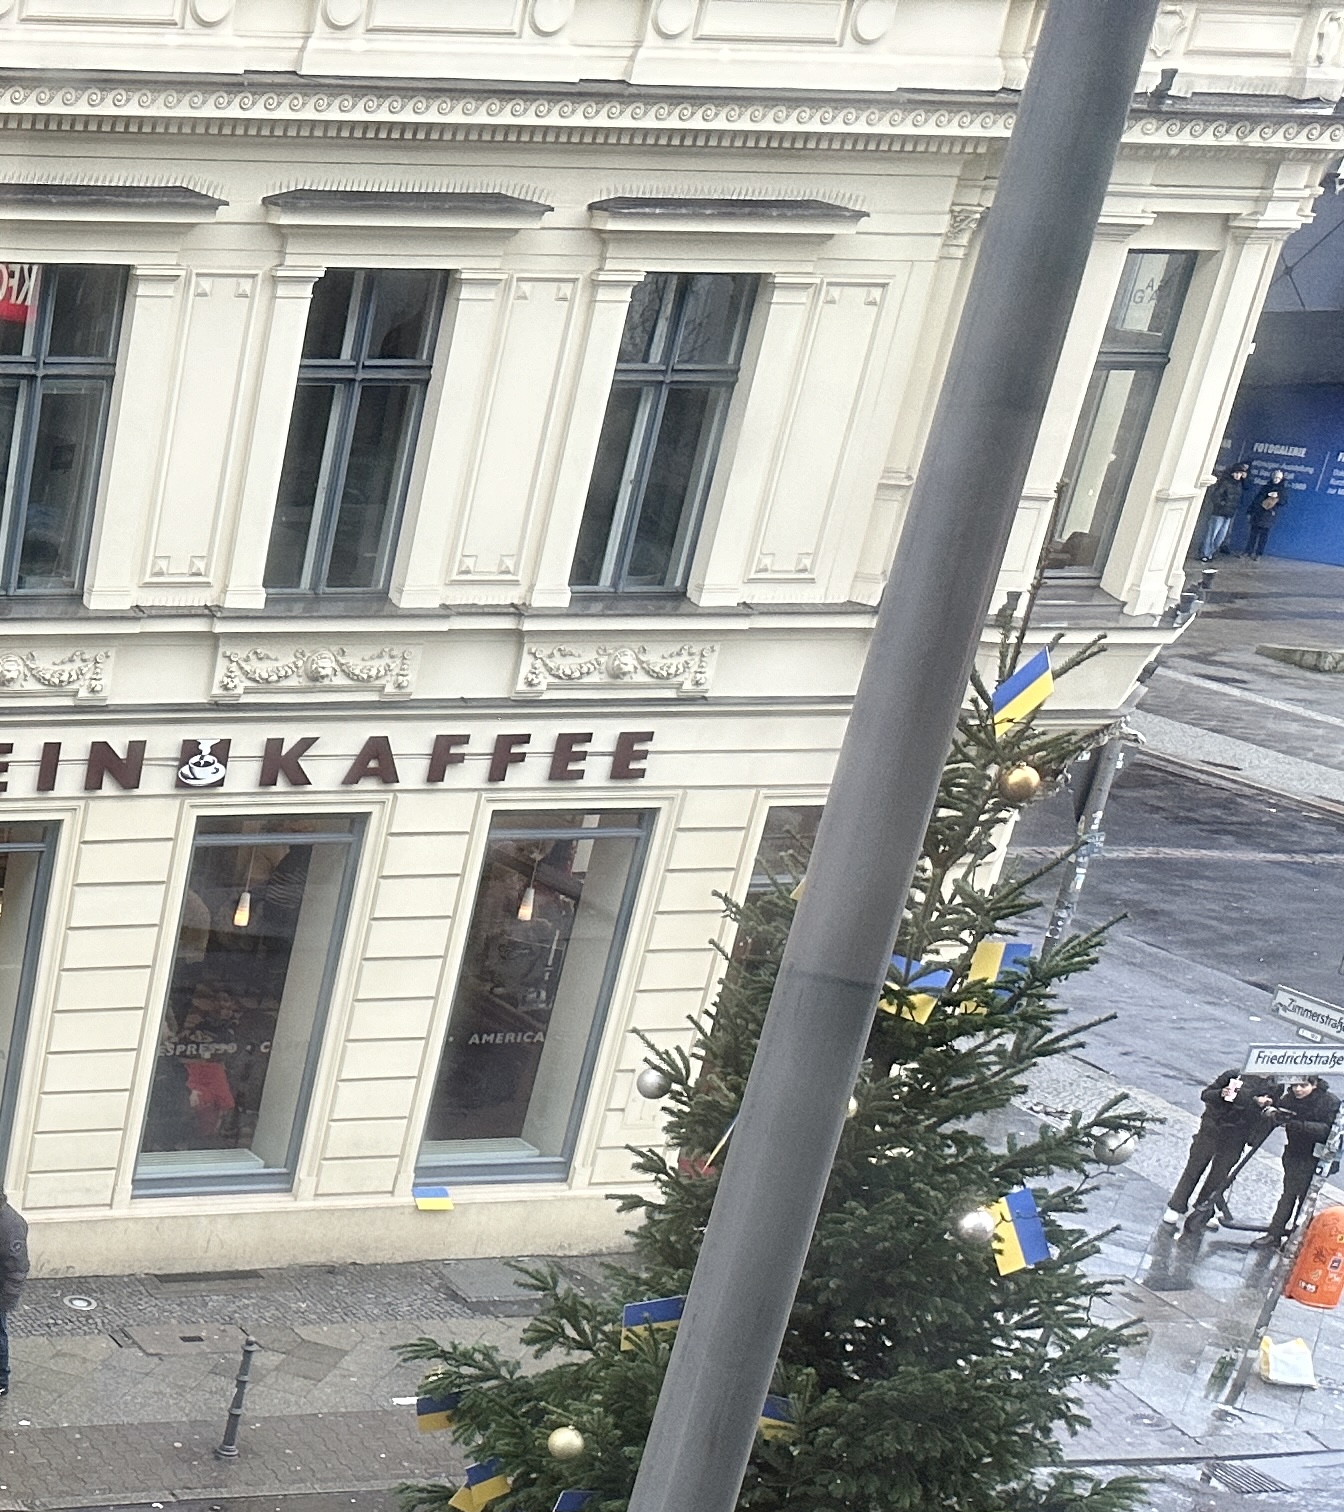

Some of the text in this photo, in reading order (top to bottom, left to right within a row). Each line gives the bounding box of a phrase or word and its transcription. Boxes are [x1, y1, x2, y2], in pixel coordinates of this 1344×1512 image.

[1253, 442, 1307, 458] FOTOGALERIE
[259, 731, 655, 787] KAFFEE
[1255, 1051, 1344, 1068] Friedrichstraße
